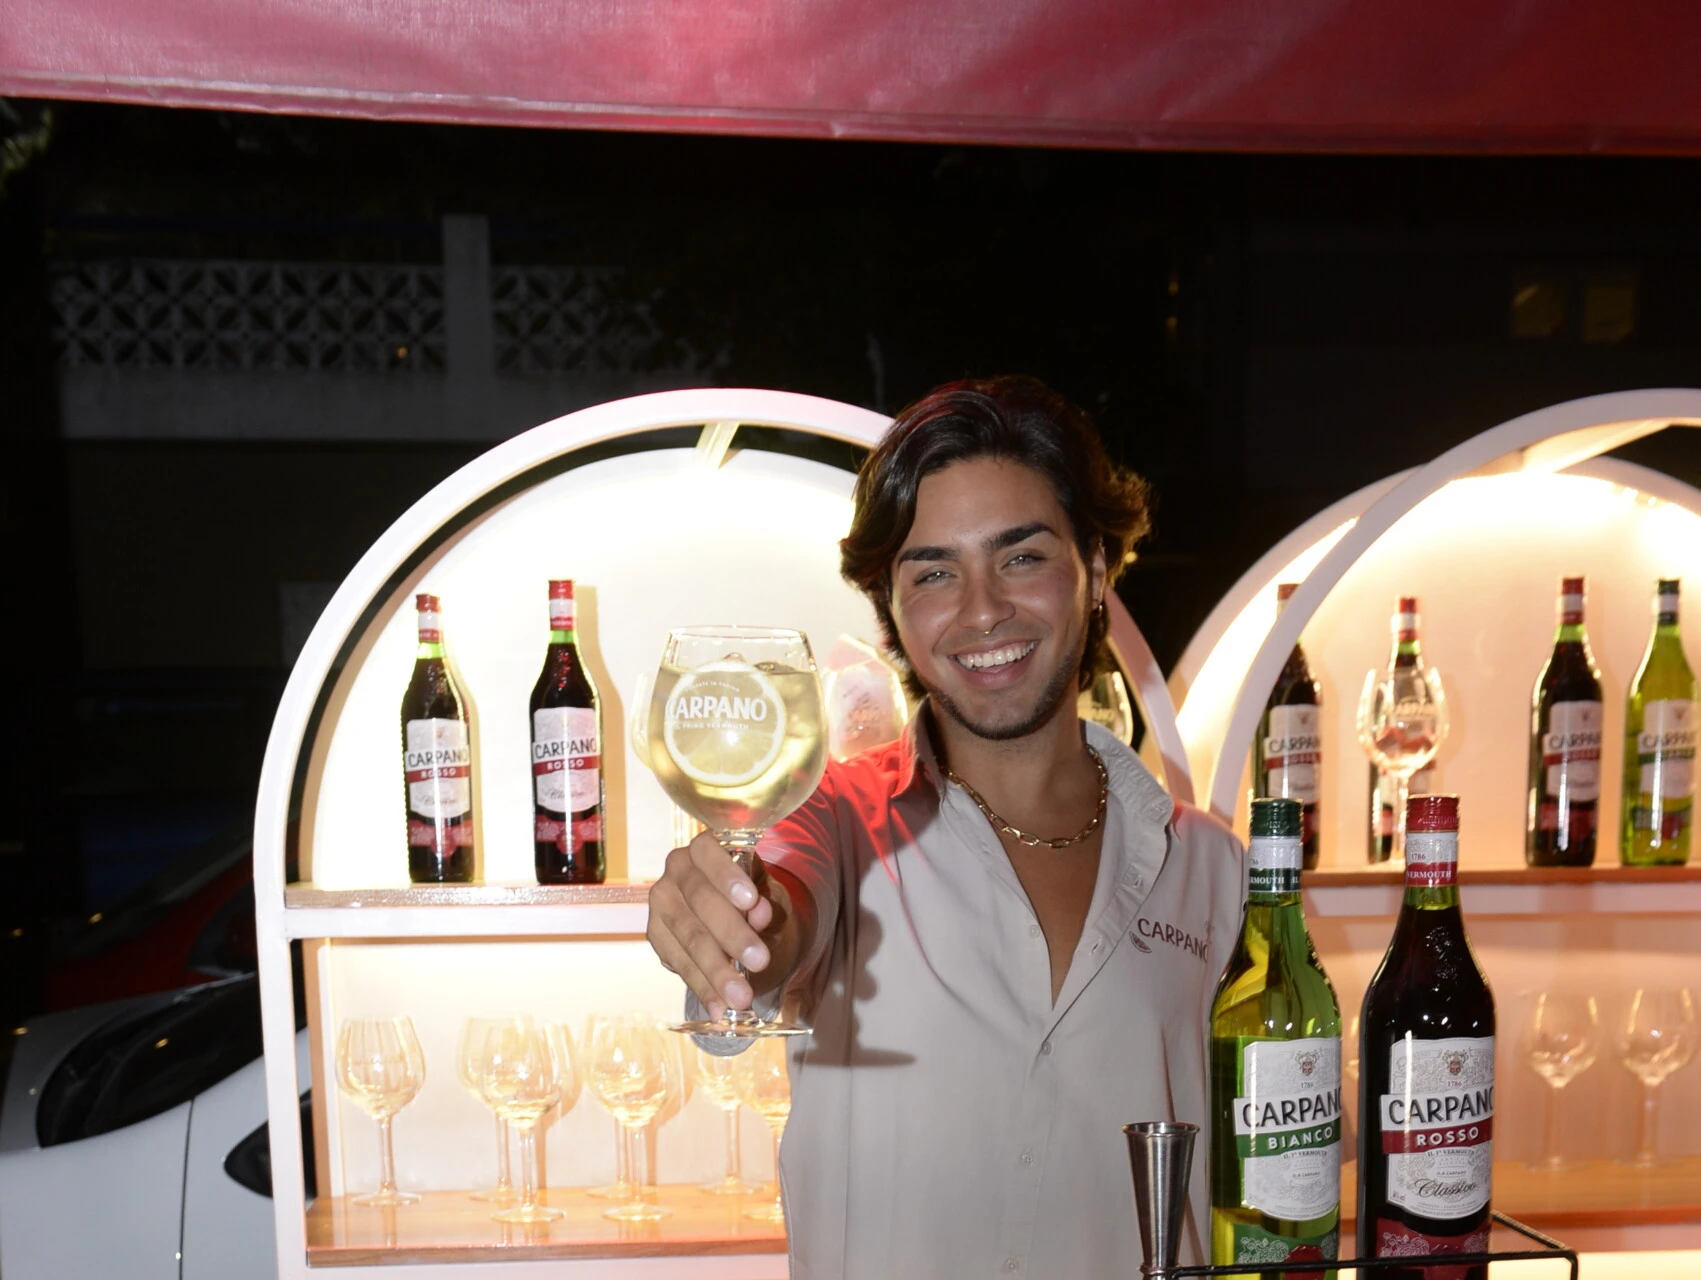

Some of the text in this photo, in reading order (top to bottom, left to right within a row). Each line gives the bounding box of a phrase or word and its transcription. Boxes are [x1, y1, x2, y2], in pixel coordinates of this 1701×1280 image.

[1411, 853, 1426, 861] 1786
[1267, 1125, 1334, 1150] BIANCO
[1416, 1125, 1480, 1147] ROSSO
